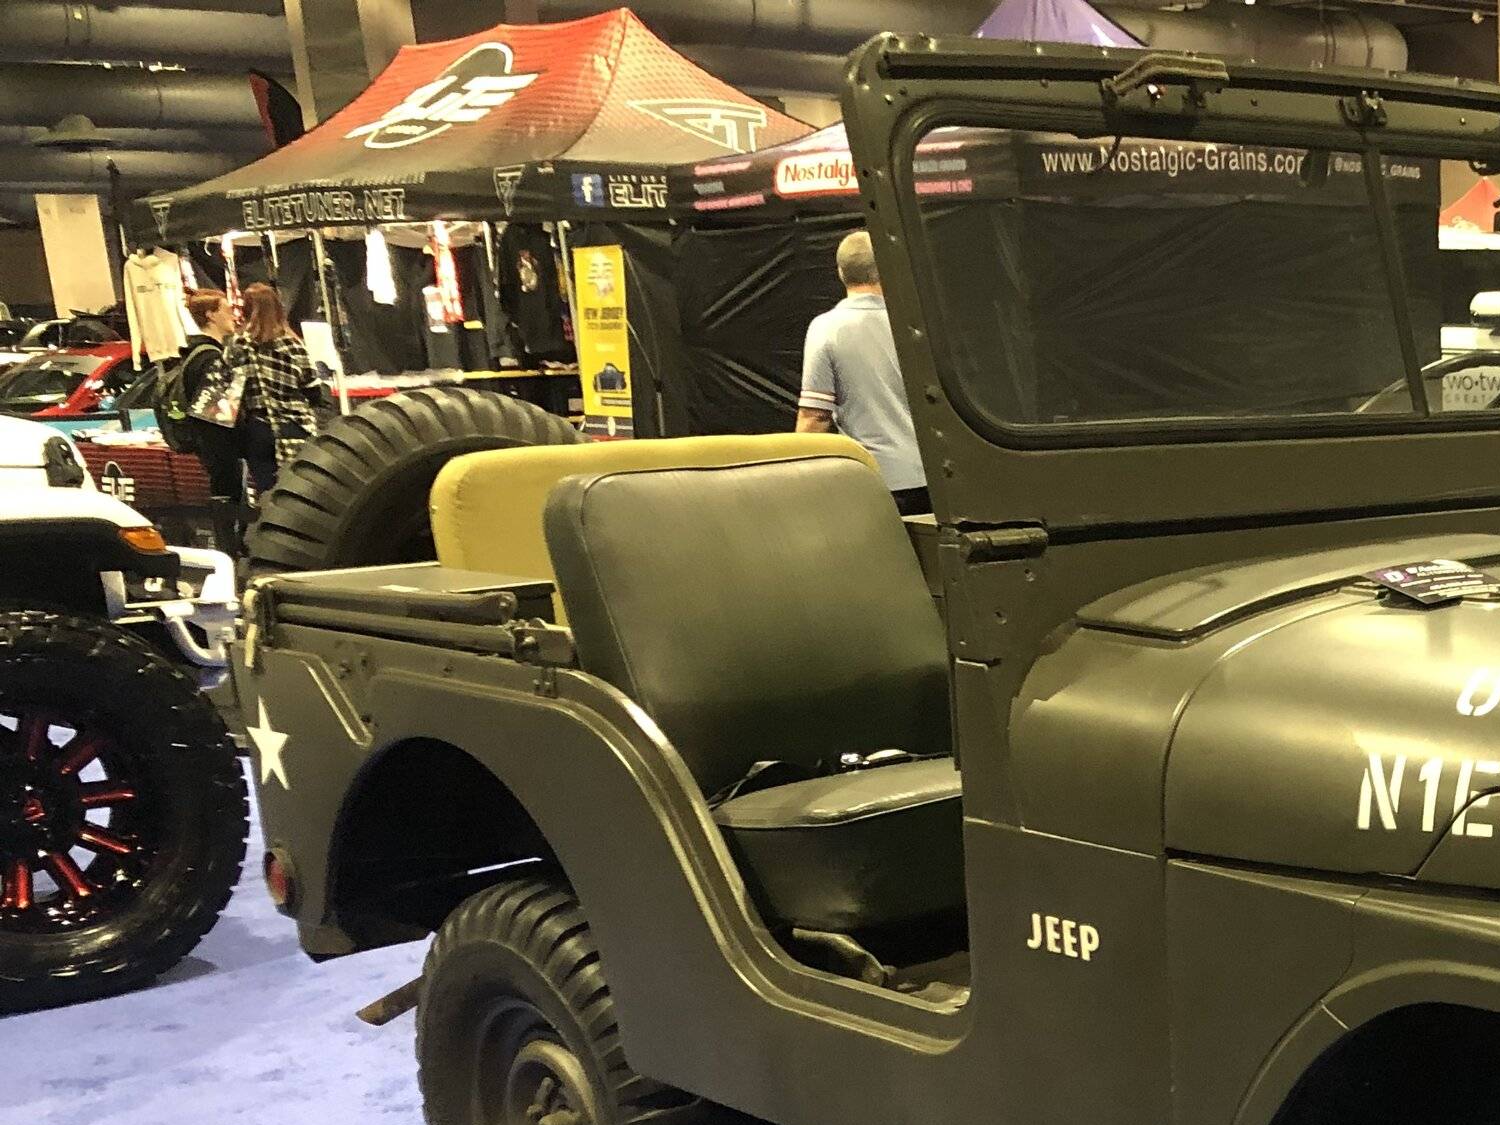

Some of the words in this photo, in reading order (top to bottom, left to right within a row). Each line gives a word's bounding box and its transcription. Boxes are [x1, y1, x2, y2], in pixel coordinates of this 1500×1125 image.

[242, 188, 406, 230] ELITETUNER.NET
[608, 182, 668, 208] ELIT
[1027, 913, 1100, 962] JEEP
